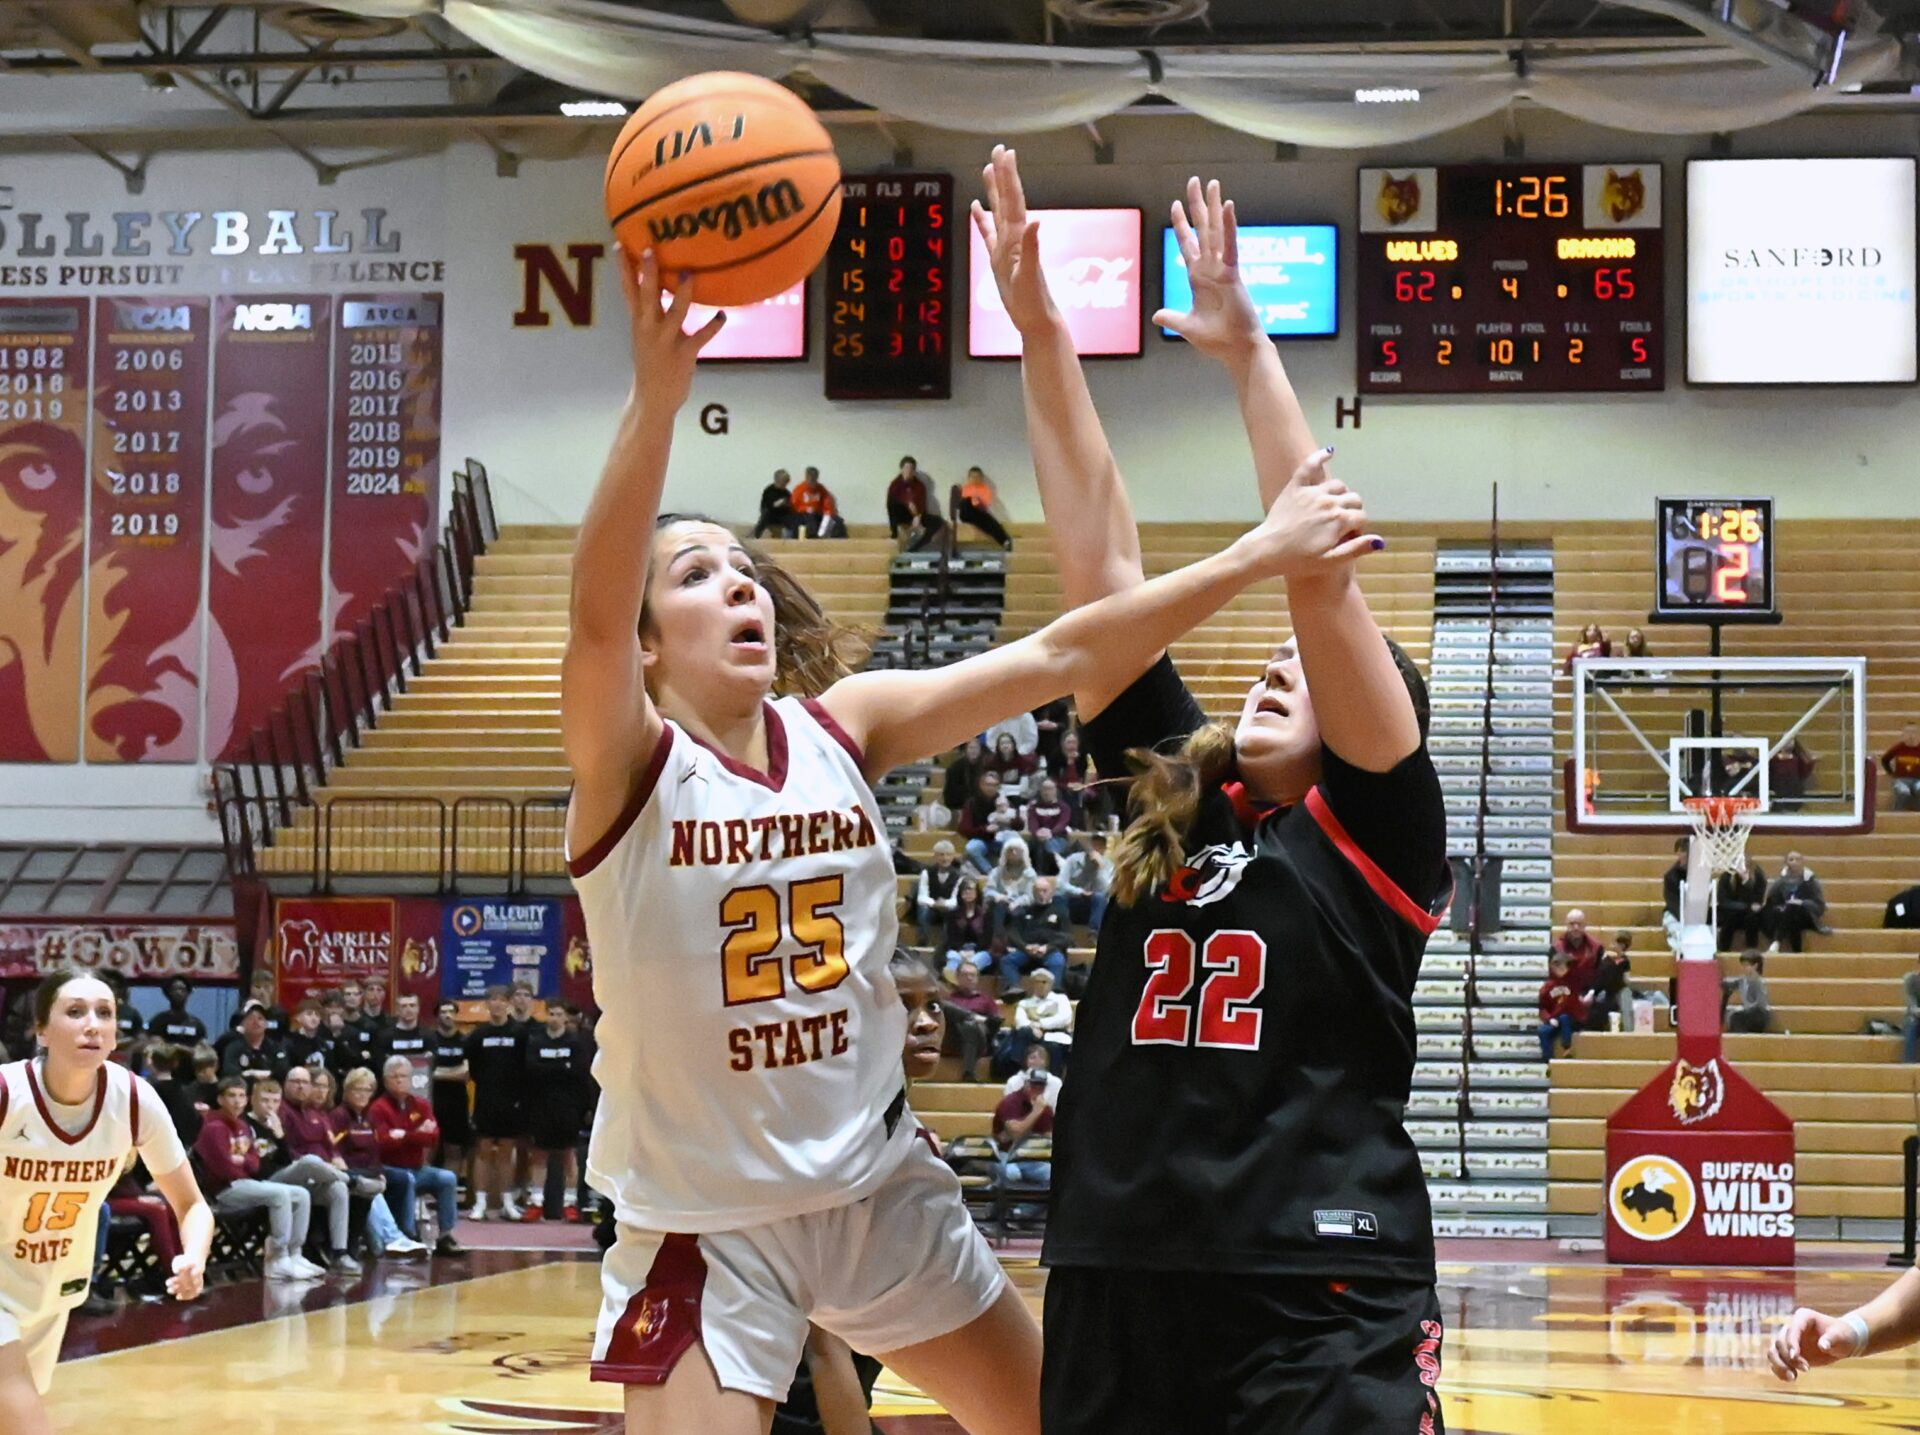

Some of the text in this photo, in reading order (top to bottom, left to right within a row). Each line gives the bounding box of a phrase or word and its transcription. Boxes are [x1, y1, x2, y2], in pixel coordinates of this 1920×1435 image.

[1495, 176, 1569, 218] 1:26
[648, 178, 805, 243] Wilson
[860, 206, 867, 228] 1
[898, 206, 905, 228] 1
[928, 203, 943, 229] 5
[0, 206, 401, 257] LLEYBALL
[850, 238, 865, 259] 4
[889, 237, 904, 261] 0
[928, 238, 942, 260] 4
[1386, 239, 1459, 262] WOLVES
[1557, 237, 1637, 261] DRAGONS
[1724, 247, 1882, 268] SANFORD
[59, 264, 184, 286] PURSUIT
[513, 243, 604, 327] N
[843, 270, 864, 293] 15
[889, 268, 904, 292] 2
[928, 267, 943, 292] 5
[1395, 270, 1436, 301] 62
[1594, 268, 1635, 299] 65
[1502, 277, 1518, 299] 4
[366, 308, 418, 321] AVCA
[833, 300, 865, 325] 24
[919, 300, 942, 324] 12
[350, 344, 402, 365] 2015
[833, 333, 864, 356] 25
[889, 332, 902, 356] 3
[919, 332, 942, 356] 17
[1382, 340, 1397, 366] 5
[1437, 340, 1453, 365] 2
[1490, 339, 1514, 365] 10
[1533, 340, 1540, 363] 1
[1568, 338, 1584, 364] 2
[1631, 337, 1647, 363] 5
[0, 347, 64, 370] 1982
[115, 350, 183, 371] 2006
[0, 373, 64, 395] 2018
[349, 370, 401, 391] 2016
[0, 399, 62, 421] 2019
[114, 391, 182, 412] 2013
[348, 396, 401, 417] 2017
[1336, 397, 1360, 429] H
[700, 403, 729, 435] G
[113, 432, 181, 453] 2017
[348, 422, 400, 443] 2018
[347, 448, 400, 469] 2019
[112, 473, 180, 494] 2018
[346, 473, 400, 495] 2024
[111, 514, 178, 536] 2019
[1701, 509, 1761, 543] 1:26
[1716, 543, 1749, 601] 2
[670, 804, 876, 867] NORTHERN
[304, 930, 391, 949] CARRELS
[719, 874, 850, 1007] 25
[318, 946, 390, 964] & BAIN
[1131, 928, 1267, 1050] 22
[728, 1009, 849, 1073] STATE
[1701, 1161, 1794, 1181] BUFFALO
[1702, 1181, 1794, 1212] WILD
[23, 1192, 90, 1233] 15
[1357, 1217, 1375, 1232] XL
[1703, 1213, 1796, 1237] WINGS
[14, 1237, 73, 1265] STATE
